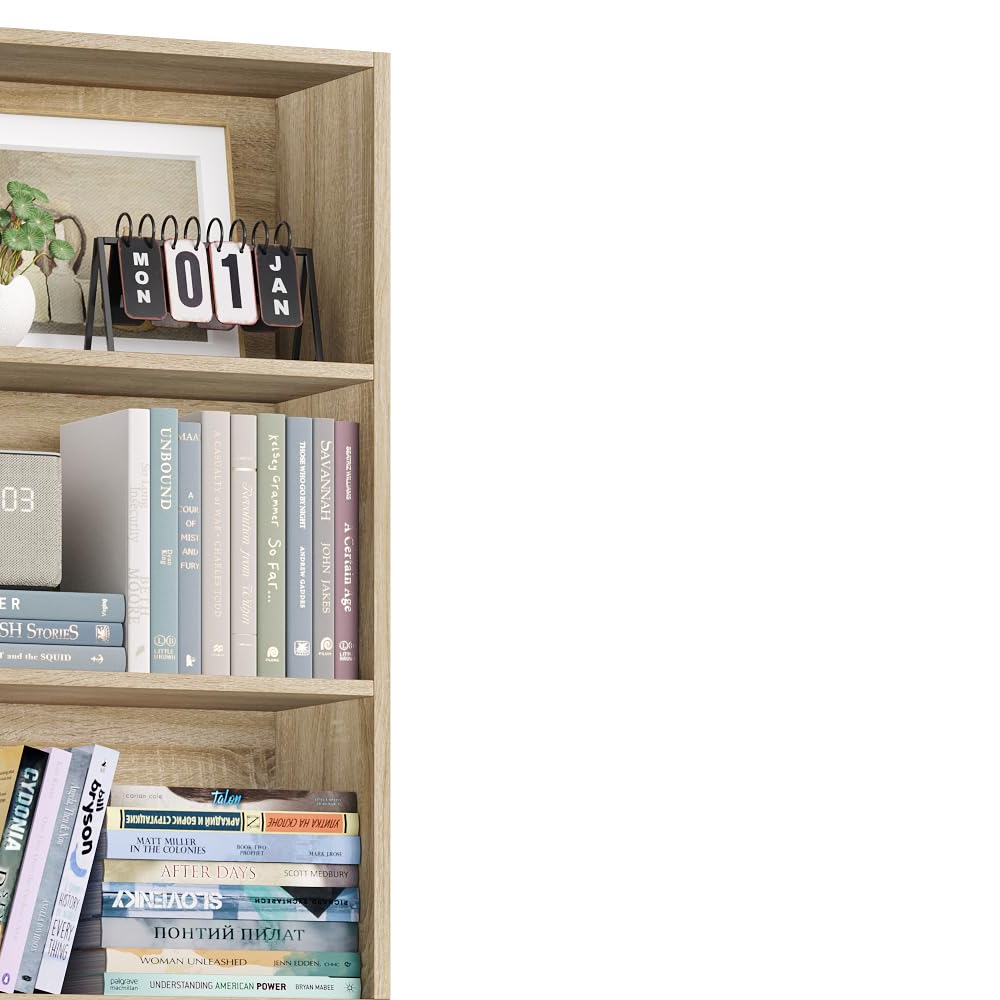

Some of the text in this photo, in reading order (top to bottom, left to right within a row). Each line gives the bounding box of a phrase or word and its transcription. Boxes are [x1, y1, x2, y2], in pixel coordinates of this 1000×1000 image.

[132, 251, 290, 316] MON 01 JAN
[160, 427, 172, 510] UNBOUND
[267, 434, 281, 527] Kelsey Grammer
[320, 440, 333, 521] SAVANNAH
[188, 491, 194, 499] A
[182, 548, 199, 556] AND
[267, 537, 281, 556] So
[180, 562, 200, 570] FURY
[341, 522, 354, 612] A Certain Age
[321, 542, 331, 614] JOHN JAKES
[128, 568, 140, 624] MOORE
[26, 624, 79, 641] STORIES
[7, 651, 23, 660] and
[25, 652, 38, 661] the
[41, 652, 72, 662] SQUID
[96, 790, 105, 812] bill
[211, 789, 242, 808] talon
[5, 767, 39, 850] CYDONIA
[81, 779, 101, 855] bryson
[126, 814, 171, 824] СТРУГАЦКИЕ
[173, 816, 196, 825] БОРИС
[205, 815, 240, 826] АРКАДИЙ
[267, 818, 297, 827] СКЛОНЕ
[299, 818, 309, 827] НА
[312, 819, 340, 828] УЛИТКА
[137, 837, 161, 845] MATT
[130, 845, 206, 855] IN THE COLONIES
[162, 865, 256, 880] AFTER DAYS
[284, 869, 349, 878] SCOTT MEDBURY
[112, 890, 223, 910] SLOVENKY
[51, 920, 74, 941] EVERY
[154, 925, 305, 940] ПОНТИЙ ПИЛАТ
[48, 939, 69, 960] THING
[140, 957, 247, 967] WOMAN UNLEASHED
[150, 981, 213, 990] UNDERSTANDING
[215, 981, 254, 990] AMERICAN
